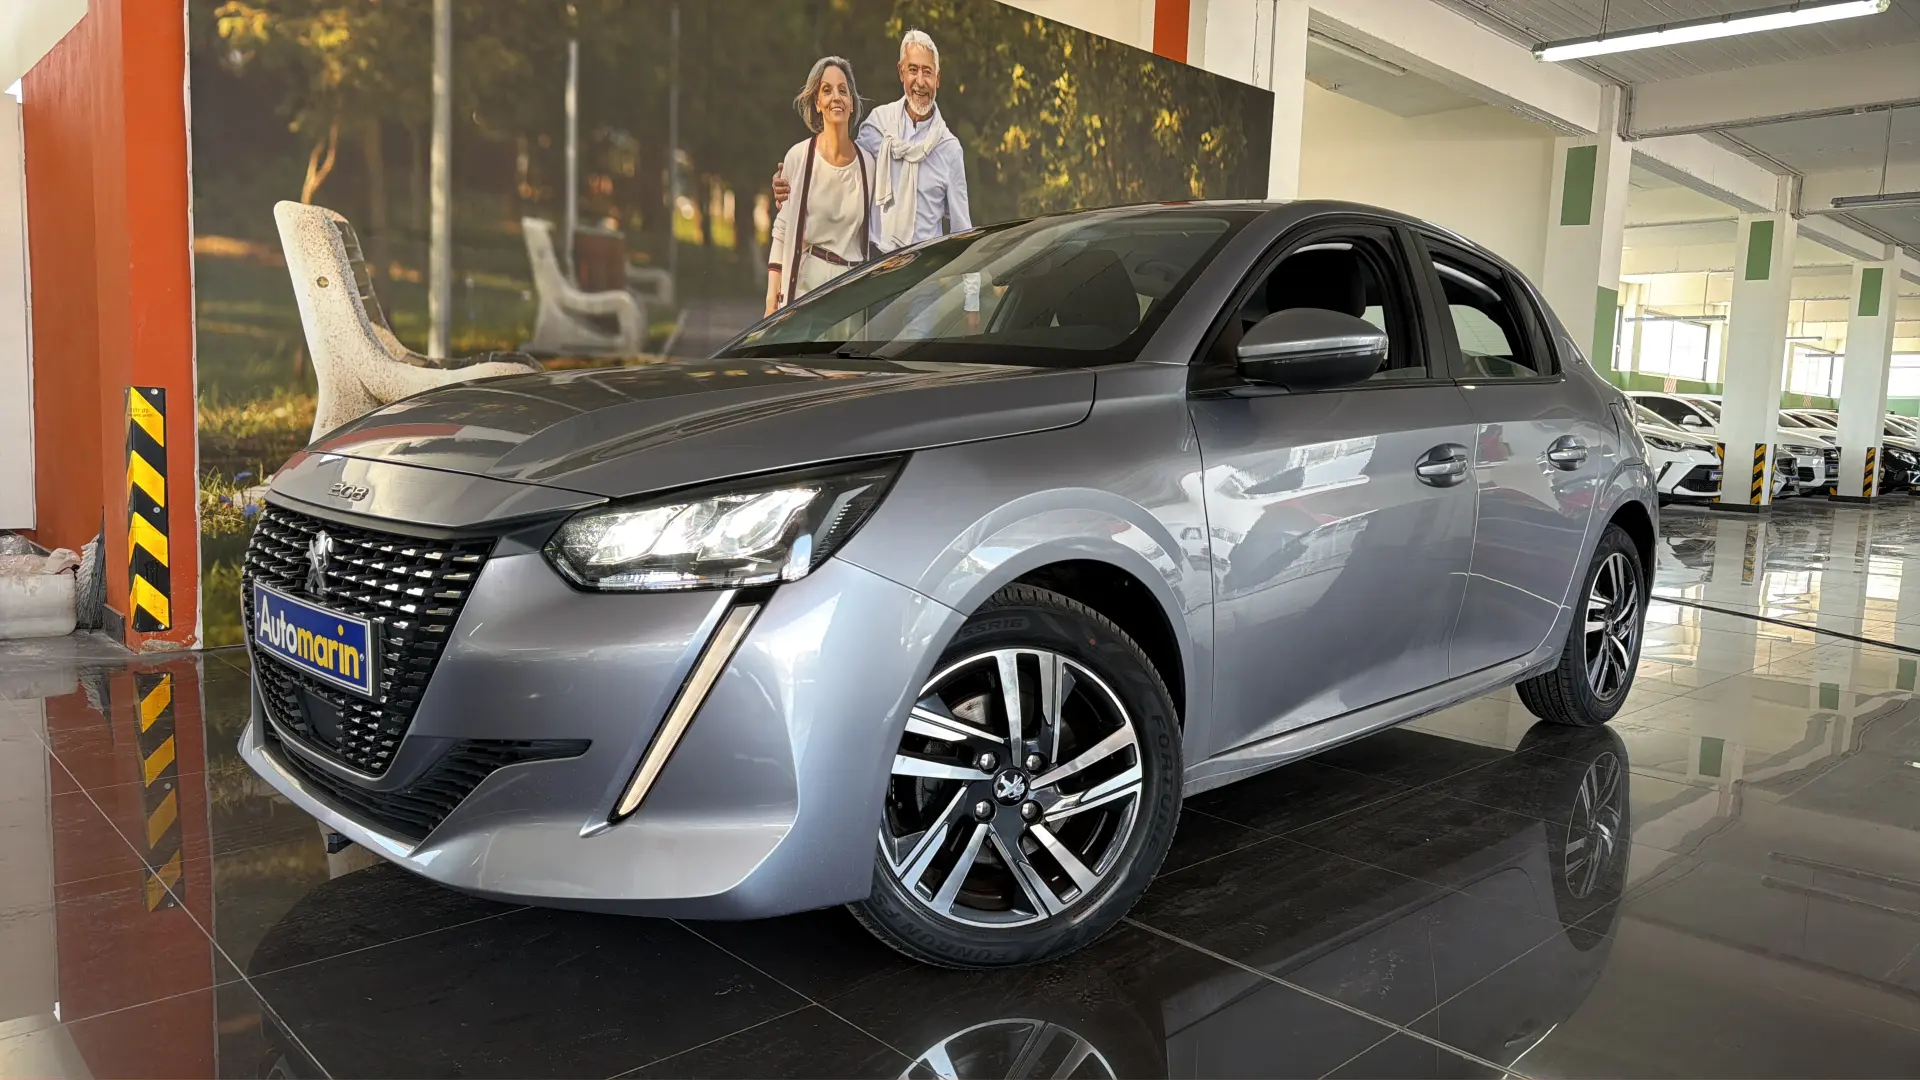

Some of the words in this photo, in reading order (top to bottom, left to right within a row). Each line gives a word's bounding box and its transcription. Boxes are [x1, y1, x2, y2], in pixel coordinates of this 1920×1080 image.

[329, 482, 370, 501] 208
[259, 594, 360, 680] Automarin
[1149, 714, 1174, 854] FORTUNE
[899, 922, 1012, 962] FUNRUN
